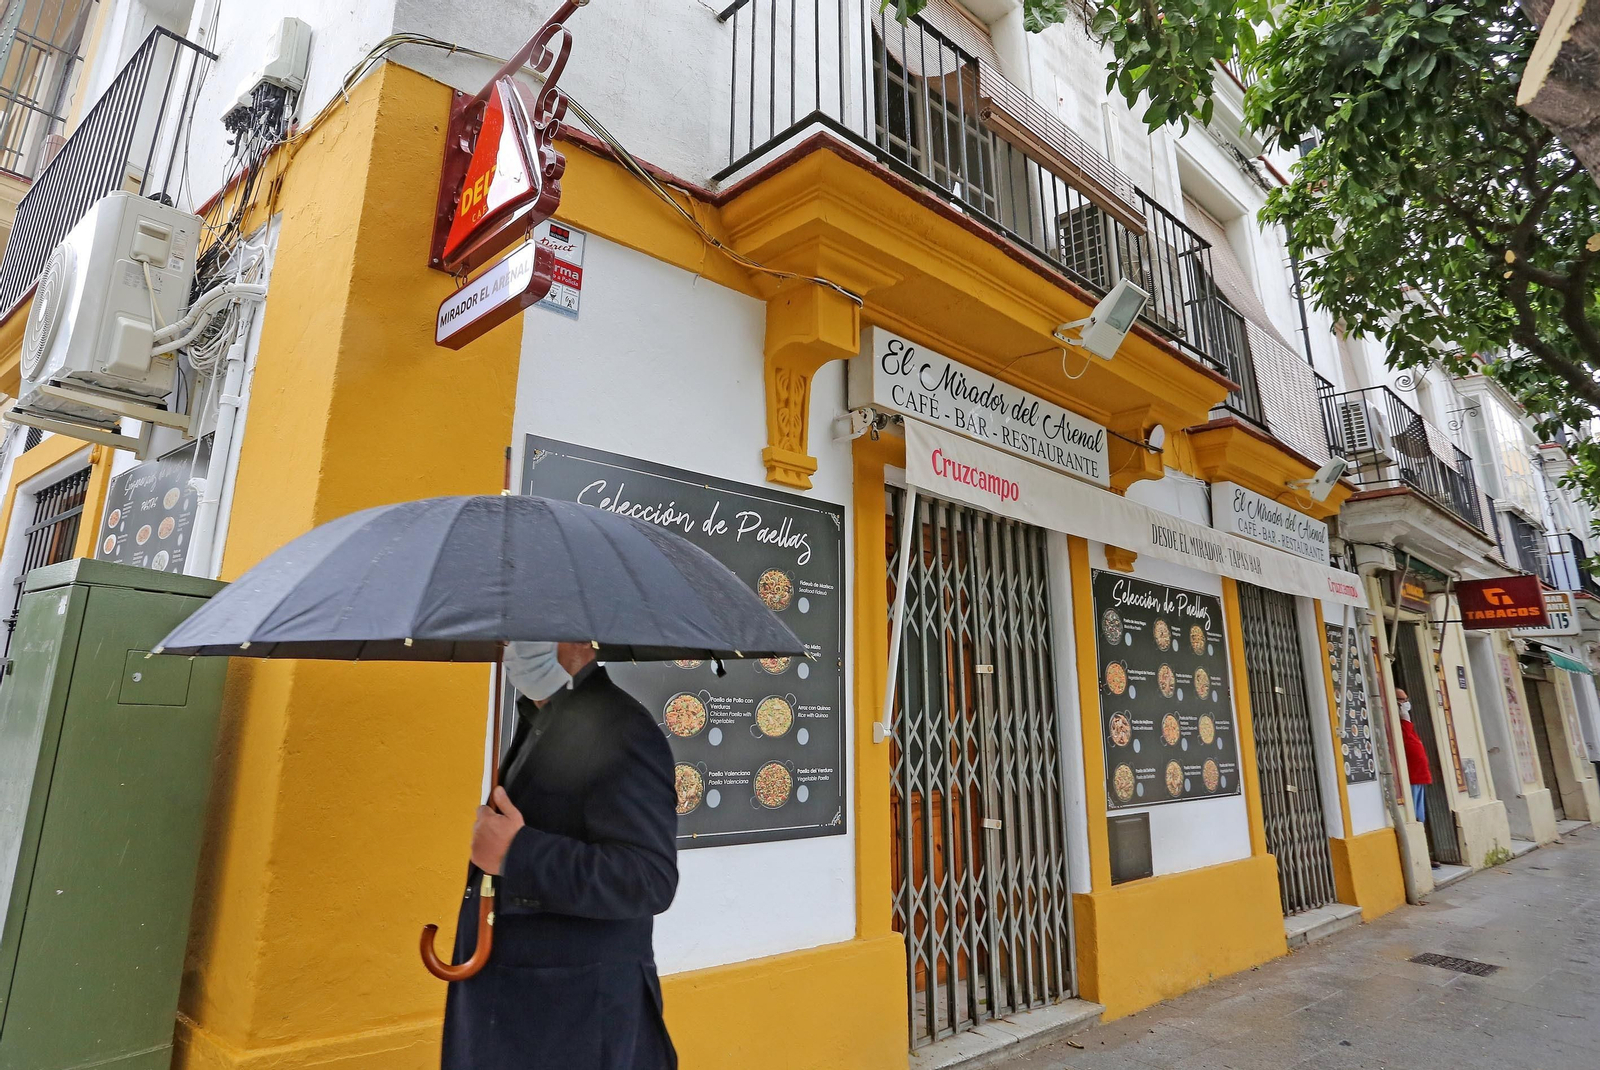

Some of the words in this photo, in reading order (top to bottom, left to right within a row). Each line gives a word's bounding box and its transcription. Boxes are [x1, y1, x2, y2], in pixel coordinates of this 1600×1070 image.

[461, 164, 497, 217] DEL
[540, 237, 576, 252] Direct
[440, 292, 478, 328] MIRADOR
[480, 285, 490, 302] EL
[491, 260, 530, 295] ARENAL
[554, 265, 579, 280] rma
[881, 339, 915, 376] El
[919, 363, 1009, 415] Mirador
[1011, 396, 1039, 427] del
[1042, 413, 1103, 453] Arenal
[891, 384, 940, 420] CAFÉ
[954, 407, 989, 439] BAR
[1002, 426, 1099, 479] RESTAURANTE
[931, 448, 1020, 502] Cruzcampo
[576, 479, 695, 533] Selección
[702, 501, 728, 537] de
[735, 511, 811, 566] Paellas
[1233, 488, 1245, 512] El
[1247, 500, 1284, 527] Mirador
[1285, 512, 1297, 532] del
[1297, 521, 1326, 544] Arenal
[1152, 523, 1179, 551] DESDE
[1180, 533, 1190, 554] EL
[1190, 536, 1224, 564] MIRADOR
[1228, 547, 1250, 572] TAPAS
[1250, 556, 1262, 575] BAR
[1262, 527, 1277, 544] BAR
[1282, 534, 1325, 562] RESTAURANTE
[1112, 579, 1161, 613] Selección
[1163, 588, 1175, 614] de
[1176, 593, 1211, 631] Paellas
[1327, 577, 1358, 599] Cruzcampo
[1465, 606, 1541, 620] TABACOS
[1556, 612, 1570, 629] 15
